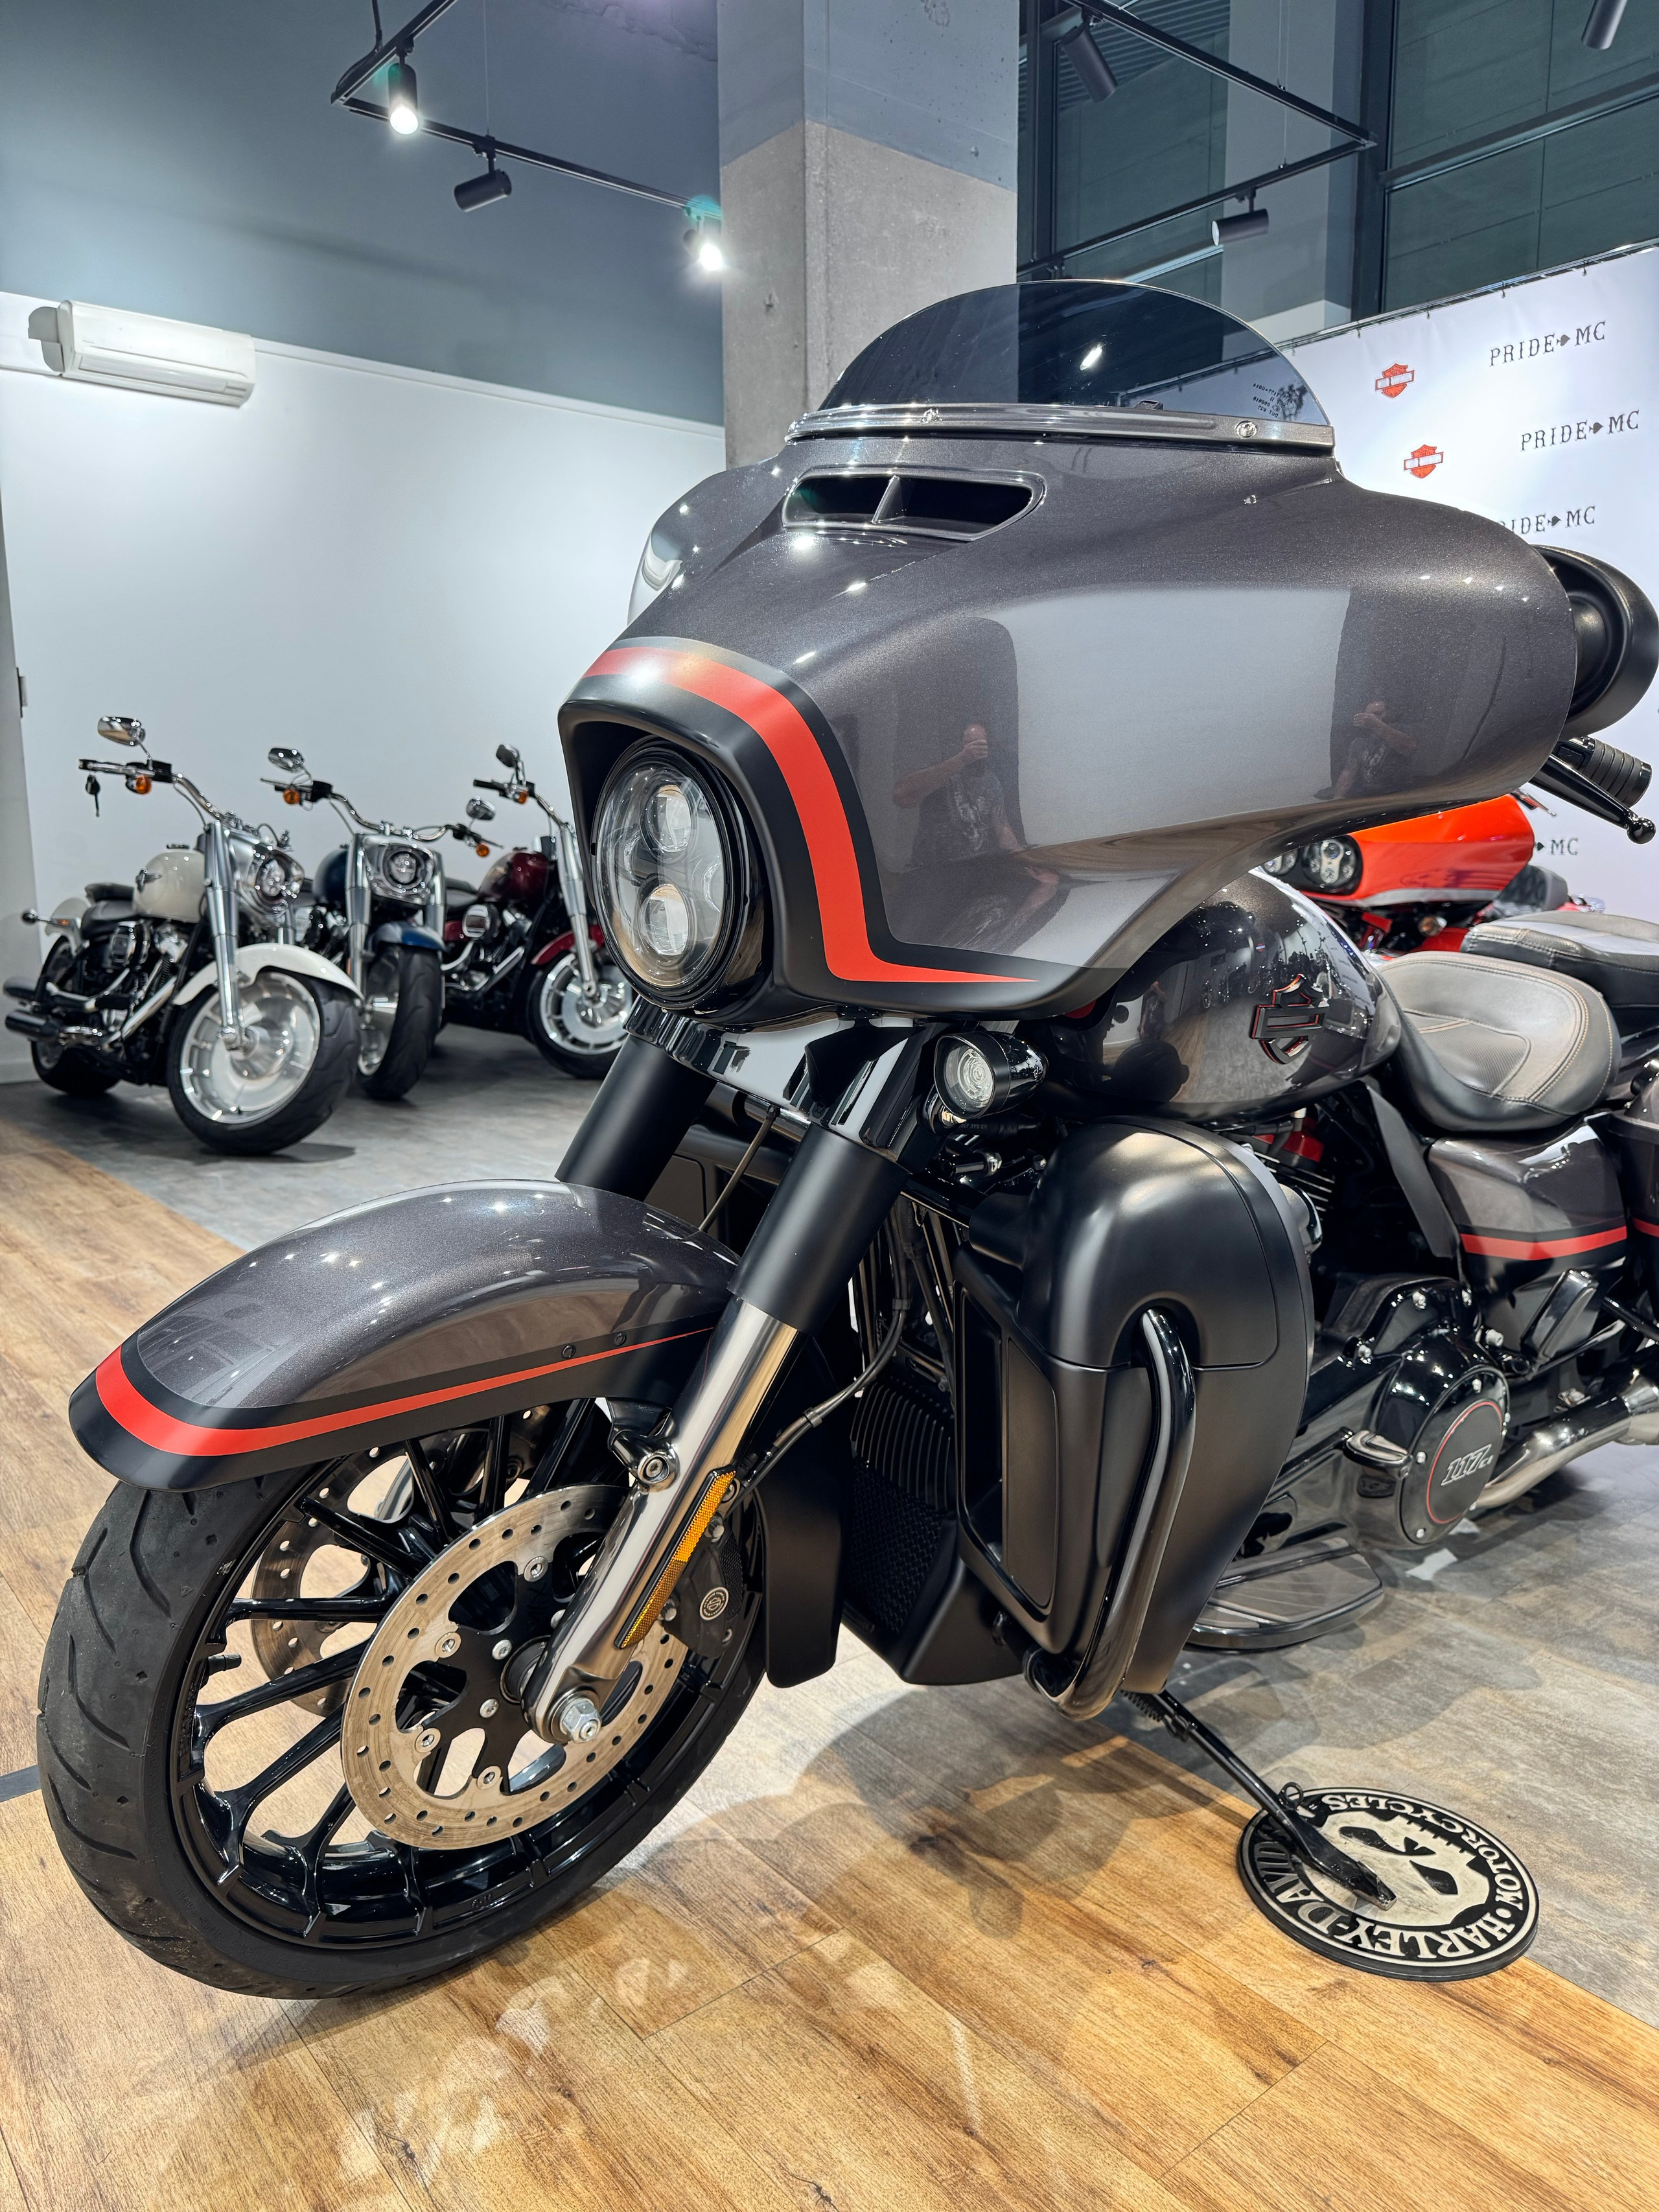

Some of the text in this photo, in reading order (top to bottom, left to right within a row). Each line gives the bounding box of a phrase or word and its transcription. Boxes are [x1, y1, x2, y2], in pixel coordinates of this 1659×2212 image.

[1489, 321, 1607, 367] PRIDE MC
[1520, 410, 1640, 452] PRIDE MC
[1497, 506, 1596, 535] IDE MC
[1549, 836, 1579, 856] MC
[1321, 1793, 1524, 1911] MOTORCYCLES
